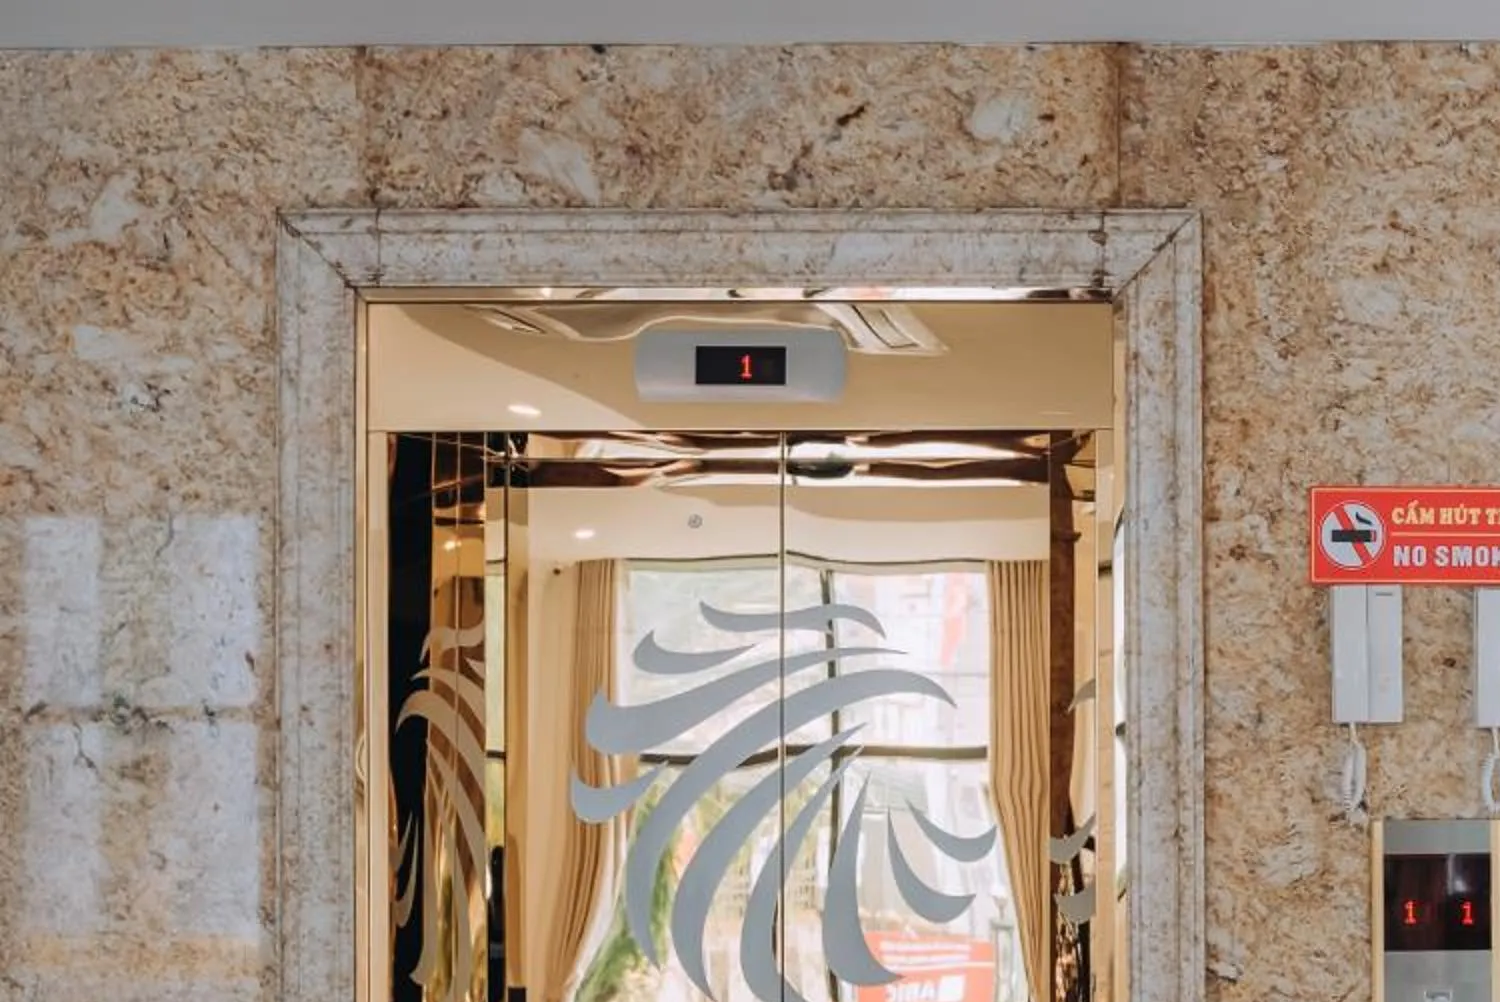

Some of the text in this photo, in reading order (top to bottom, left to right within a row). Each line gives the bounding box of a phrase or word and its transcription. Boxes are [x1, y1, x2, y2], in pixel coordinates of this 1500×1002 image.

[739, 354, 752, 379] 1
[1391, 500, 1435, 525] CẤM
[1439, 503, 1481, 525] HÚT
[1393, 545, 1427, 567] NO
[1404, 901, 1417, 924] 1
[1460, 901, 1473, 924] 1
